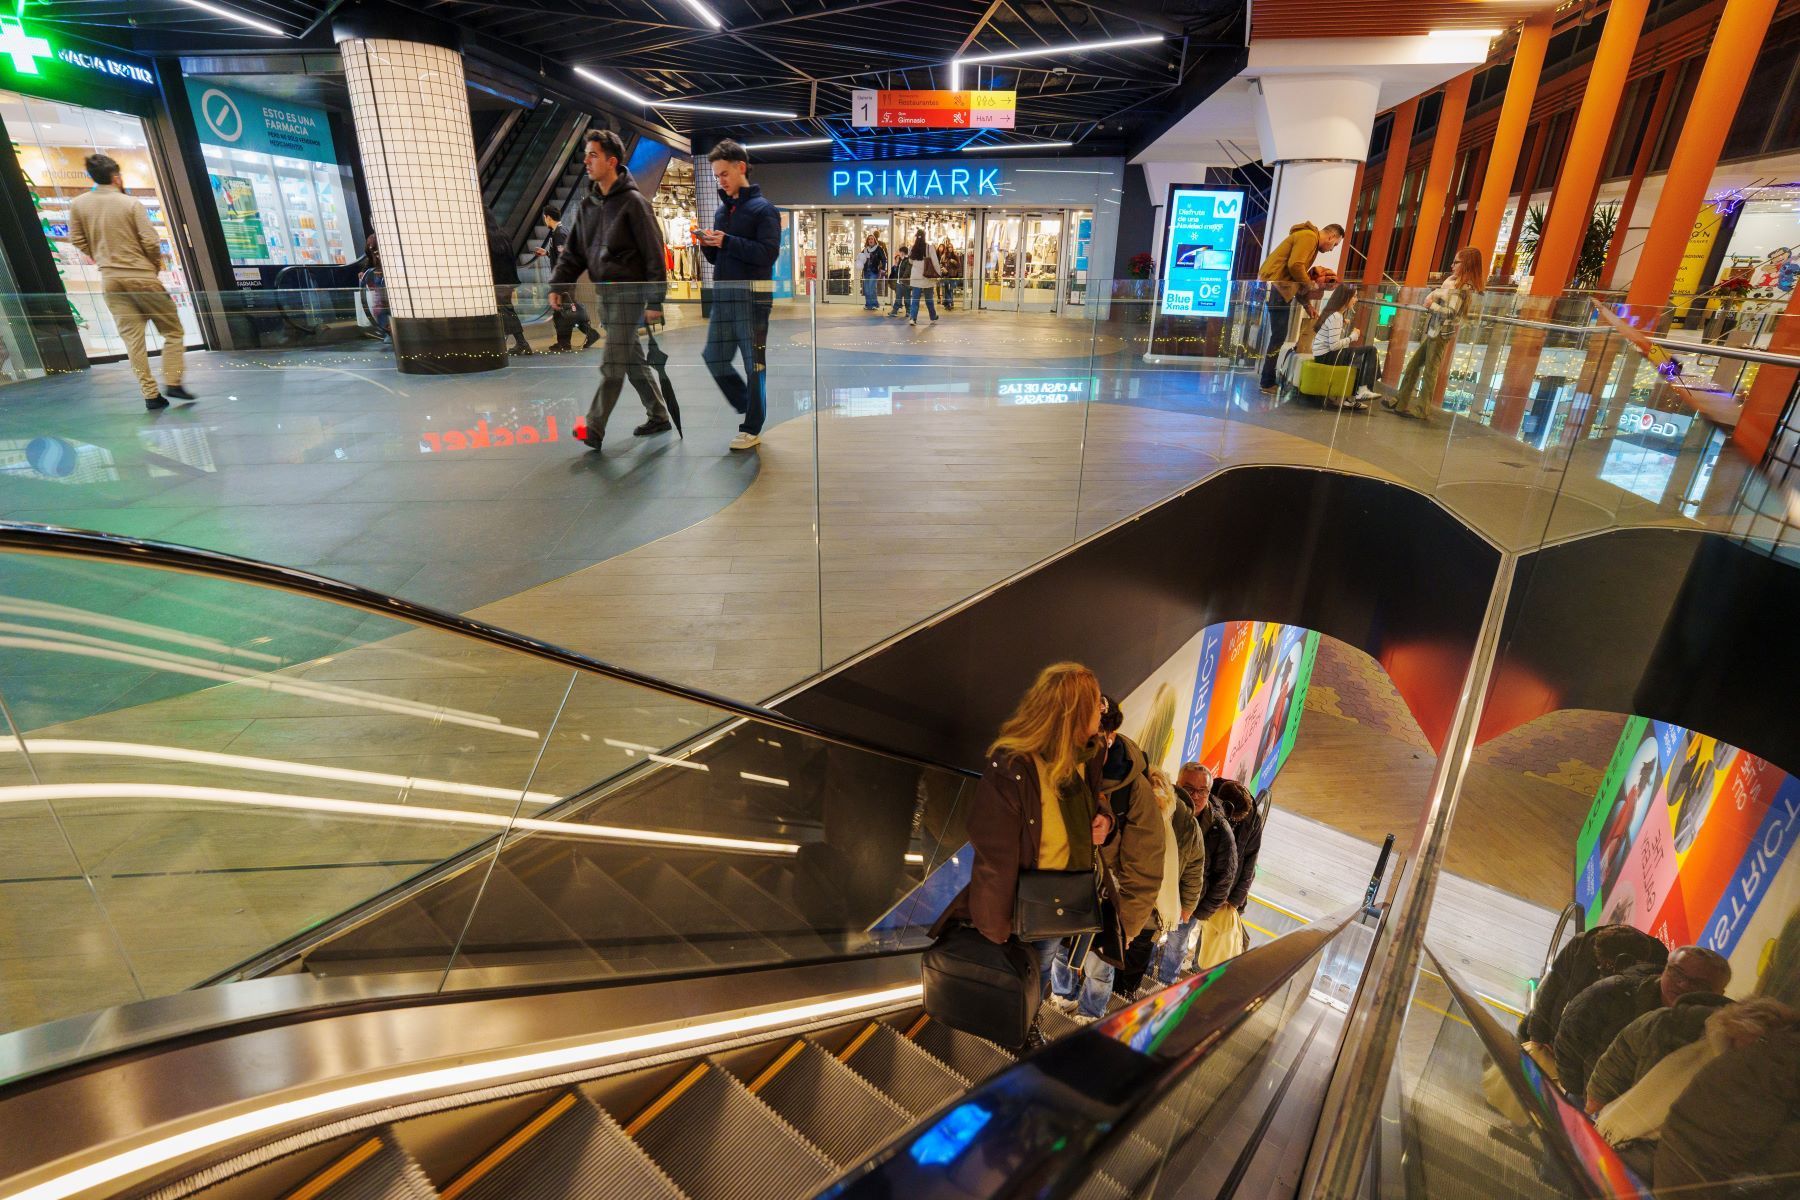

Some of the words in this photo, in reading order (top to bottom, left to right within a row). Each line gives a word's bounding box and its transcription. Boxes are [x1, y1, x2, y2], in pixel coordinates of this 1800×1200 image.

[57, 49, 107, 73] MACIA
[262, 107, 285, 120] ESTO
[285, 112, 297, 123] ES
[297, 114, 316, 127] UNA
[860, 103, 868, 121] 1
[897, 116, 926, 124] Gimnasio
[264, 118, 309, 136] FARMACIA
[832, 168, 998, 197] PRIMARK
[1166, 293, 1191, 303] Blue
[1187, 635, 1218, 762] ISTRICT
